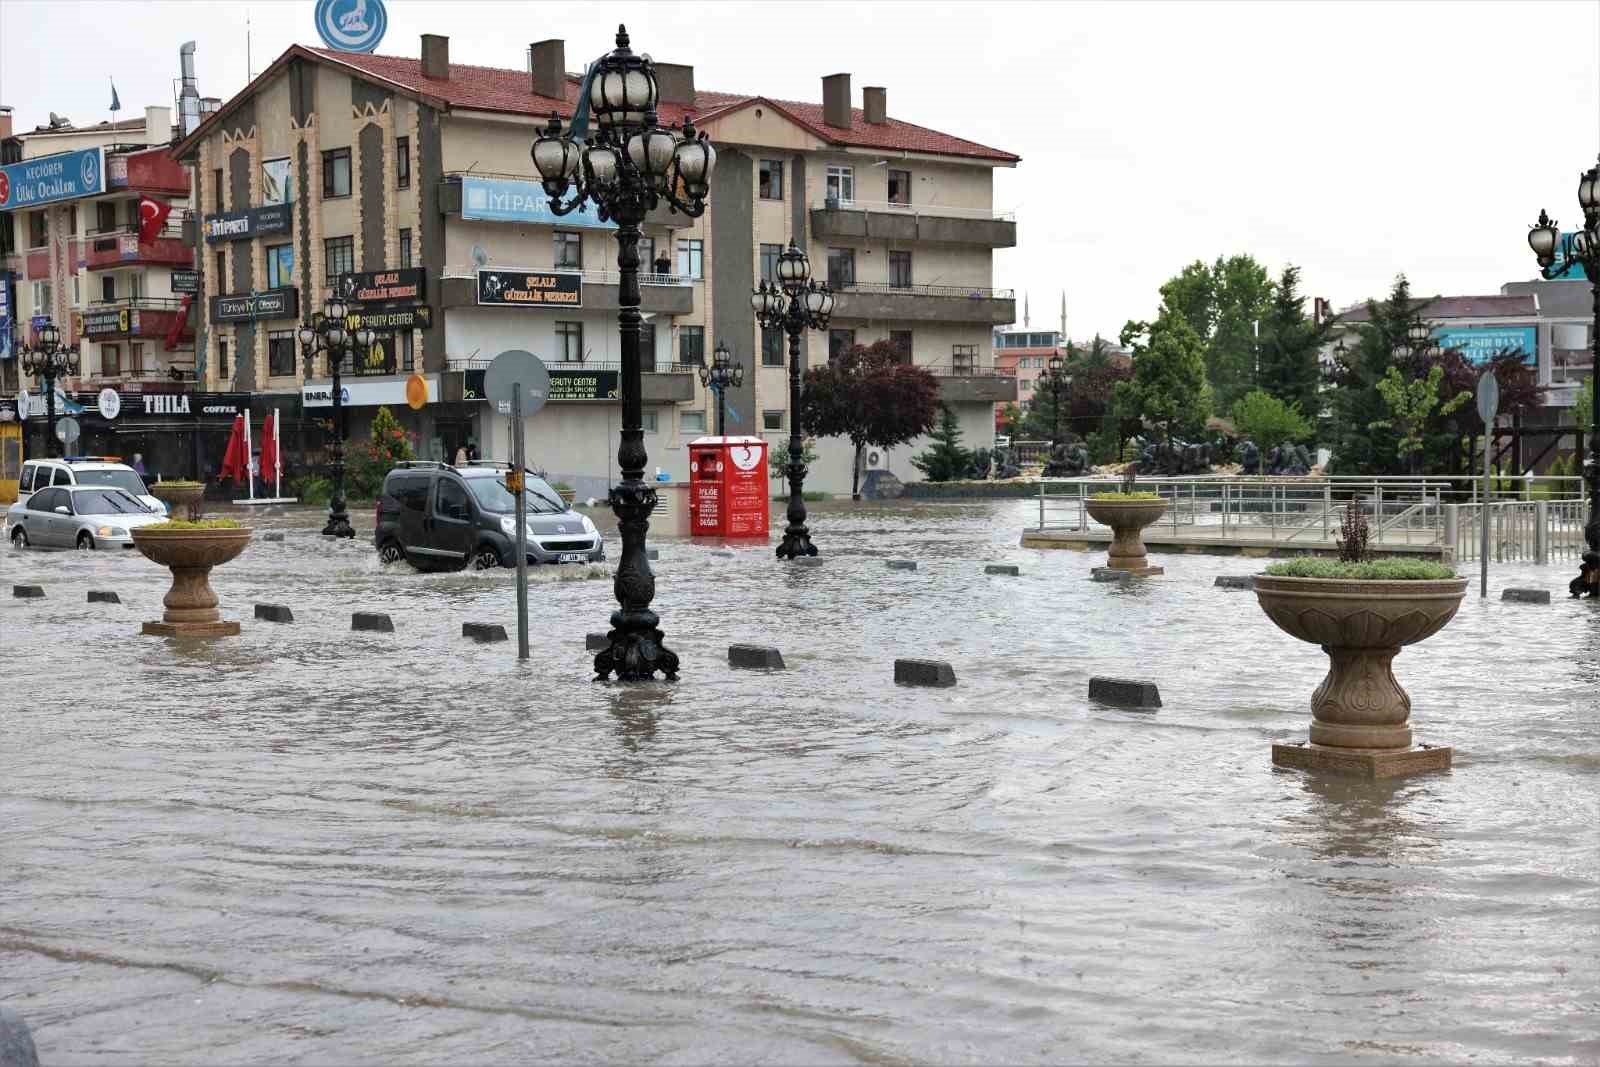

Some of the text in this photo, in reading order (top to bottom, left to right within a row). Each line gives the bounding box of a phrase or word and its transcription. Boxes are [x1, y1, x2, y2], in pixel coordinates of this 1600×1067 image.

[388, 312, 414, 326] CENTER
[573, 377, 597, 386] CENTER
[142, 395, 191, 413] THILA
